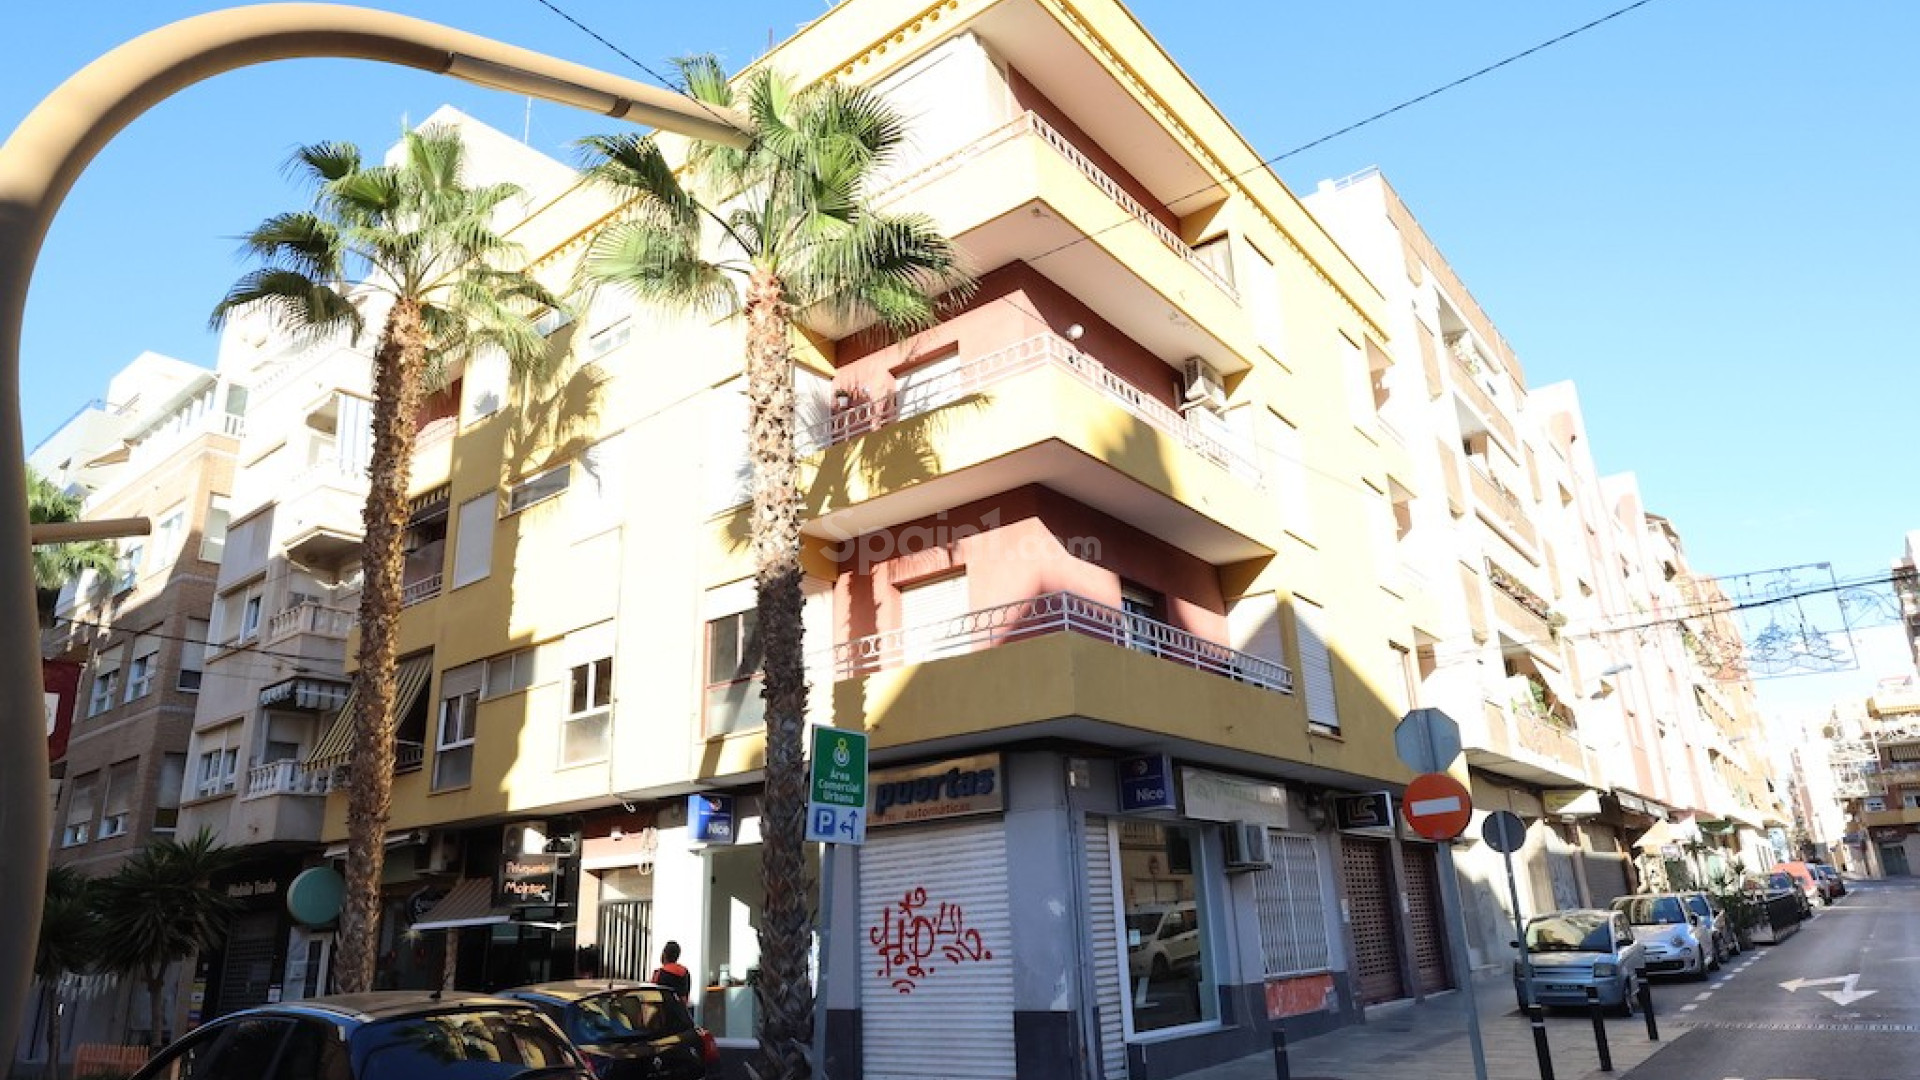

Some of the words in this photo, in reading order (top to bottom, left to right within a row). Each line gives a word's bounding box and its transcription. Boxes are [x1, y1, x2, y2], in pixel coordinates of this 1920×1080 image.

[875, 767, 995, 815] puertas
[1136, 788, 1165, 801] Nice
[708, 822, 730, 836] Nice
[818, 810, 833, 833] P
